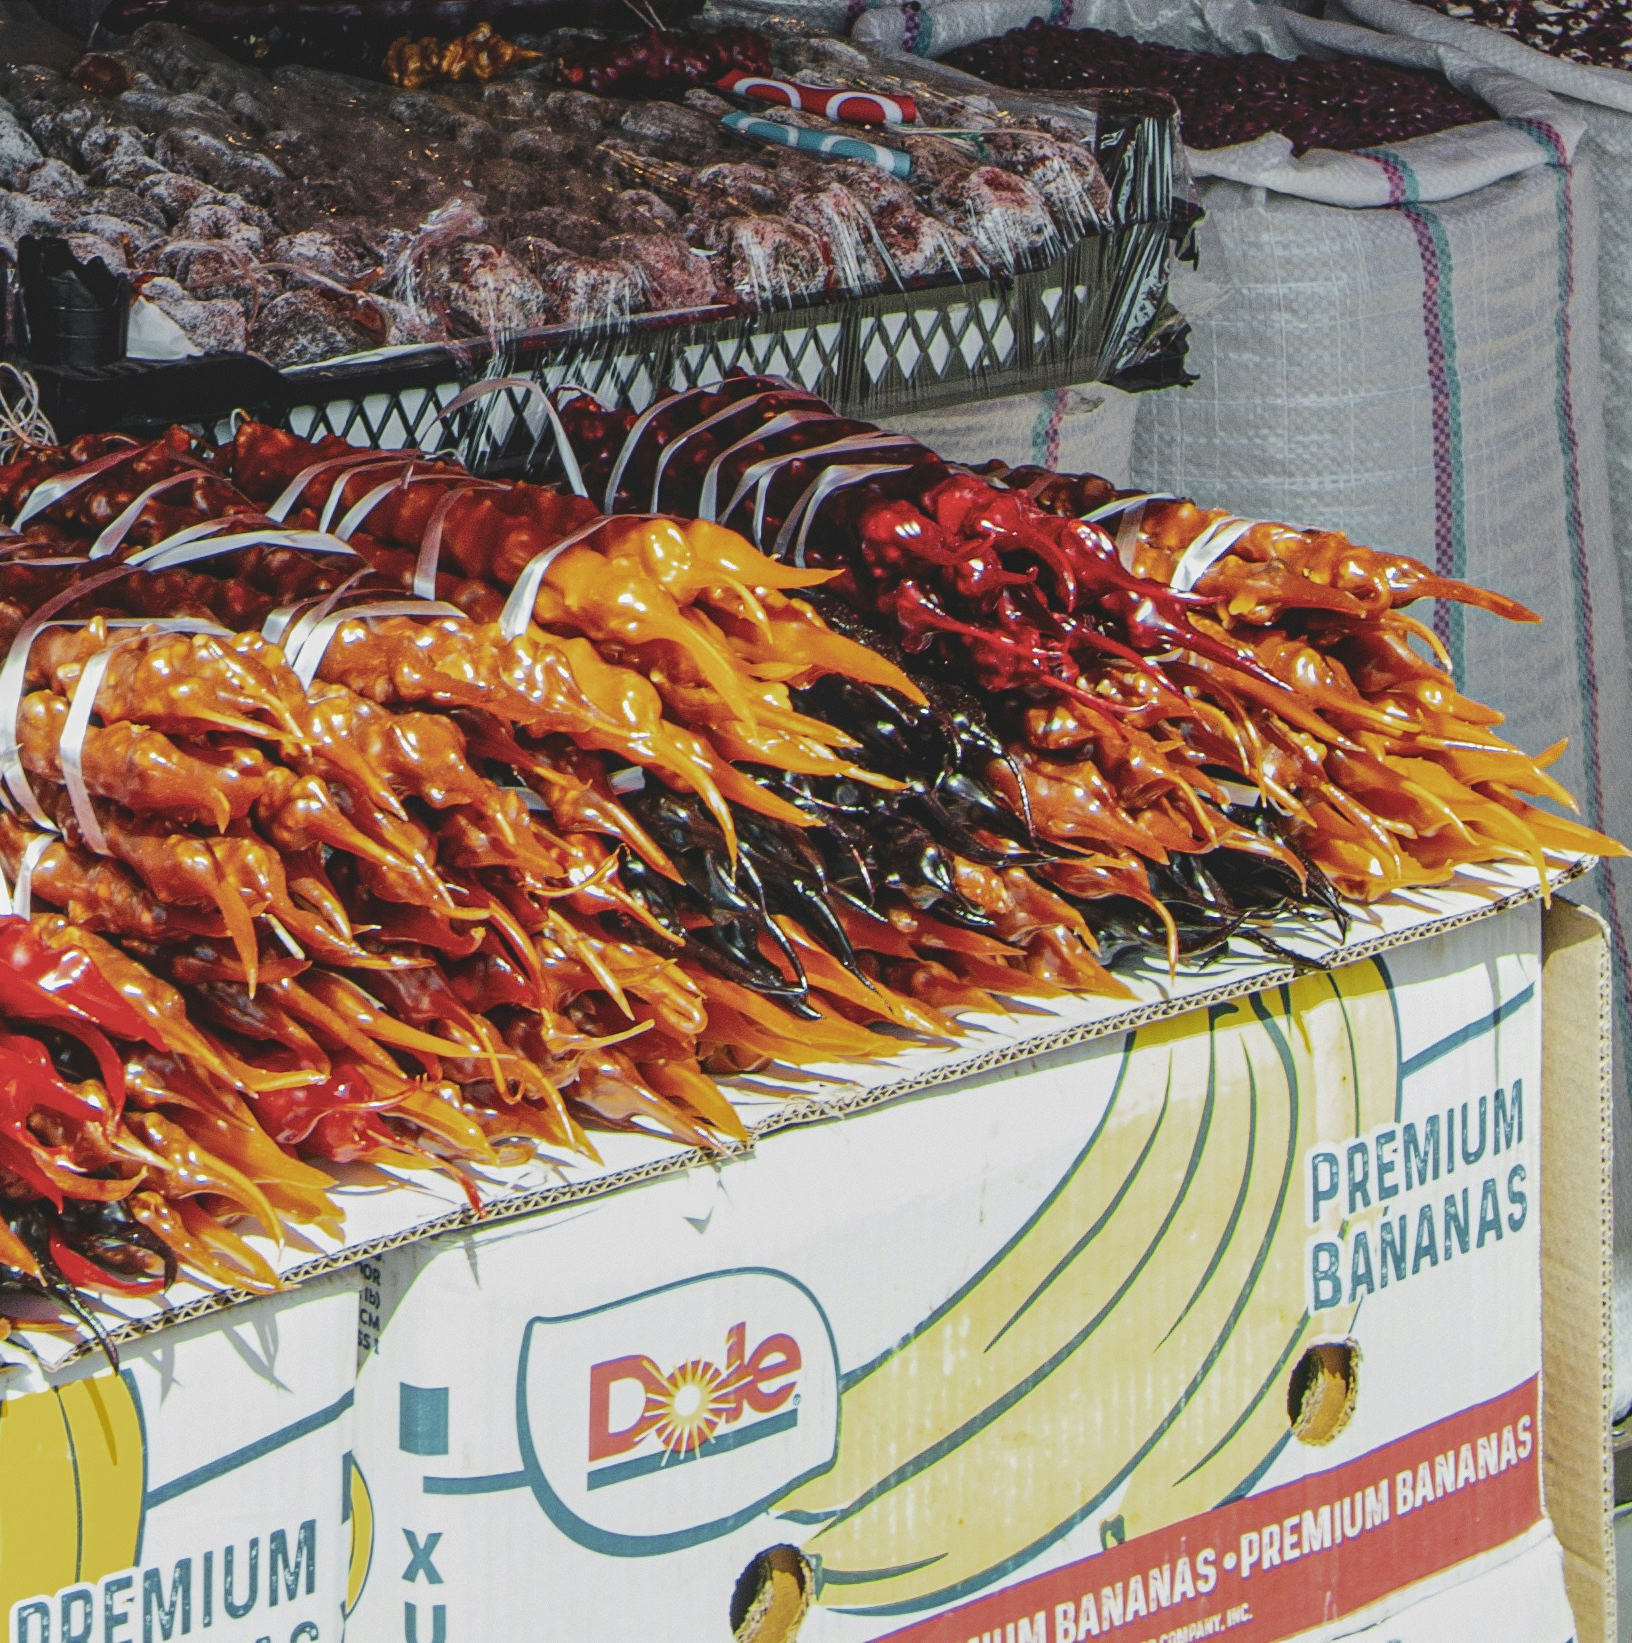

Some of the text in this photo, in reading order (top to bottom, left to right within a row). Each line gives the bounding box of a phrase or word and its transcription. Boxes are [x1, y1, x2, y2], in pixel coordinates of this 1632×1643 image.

[1312, 1078, 1523, 1223] PREMIUM
[1312, 1163, 1528, 1311] BANANAS
[588, 1321, 802, 1462] Dole
[1054, 1415, 1533, 1643] BANANAS PREMIUM BANANAS
[1226, 1602, 1254, 1628] INC.
